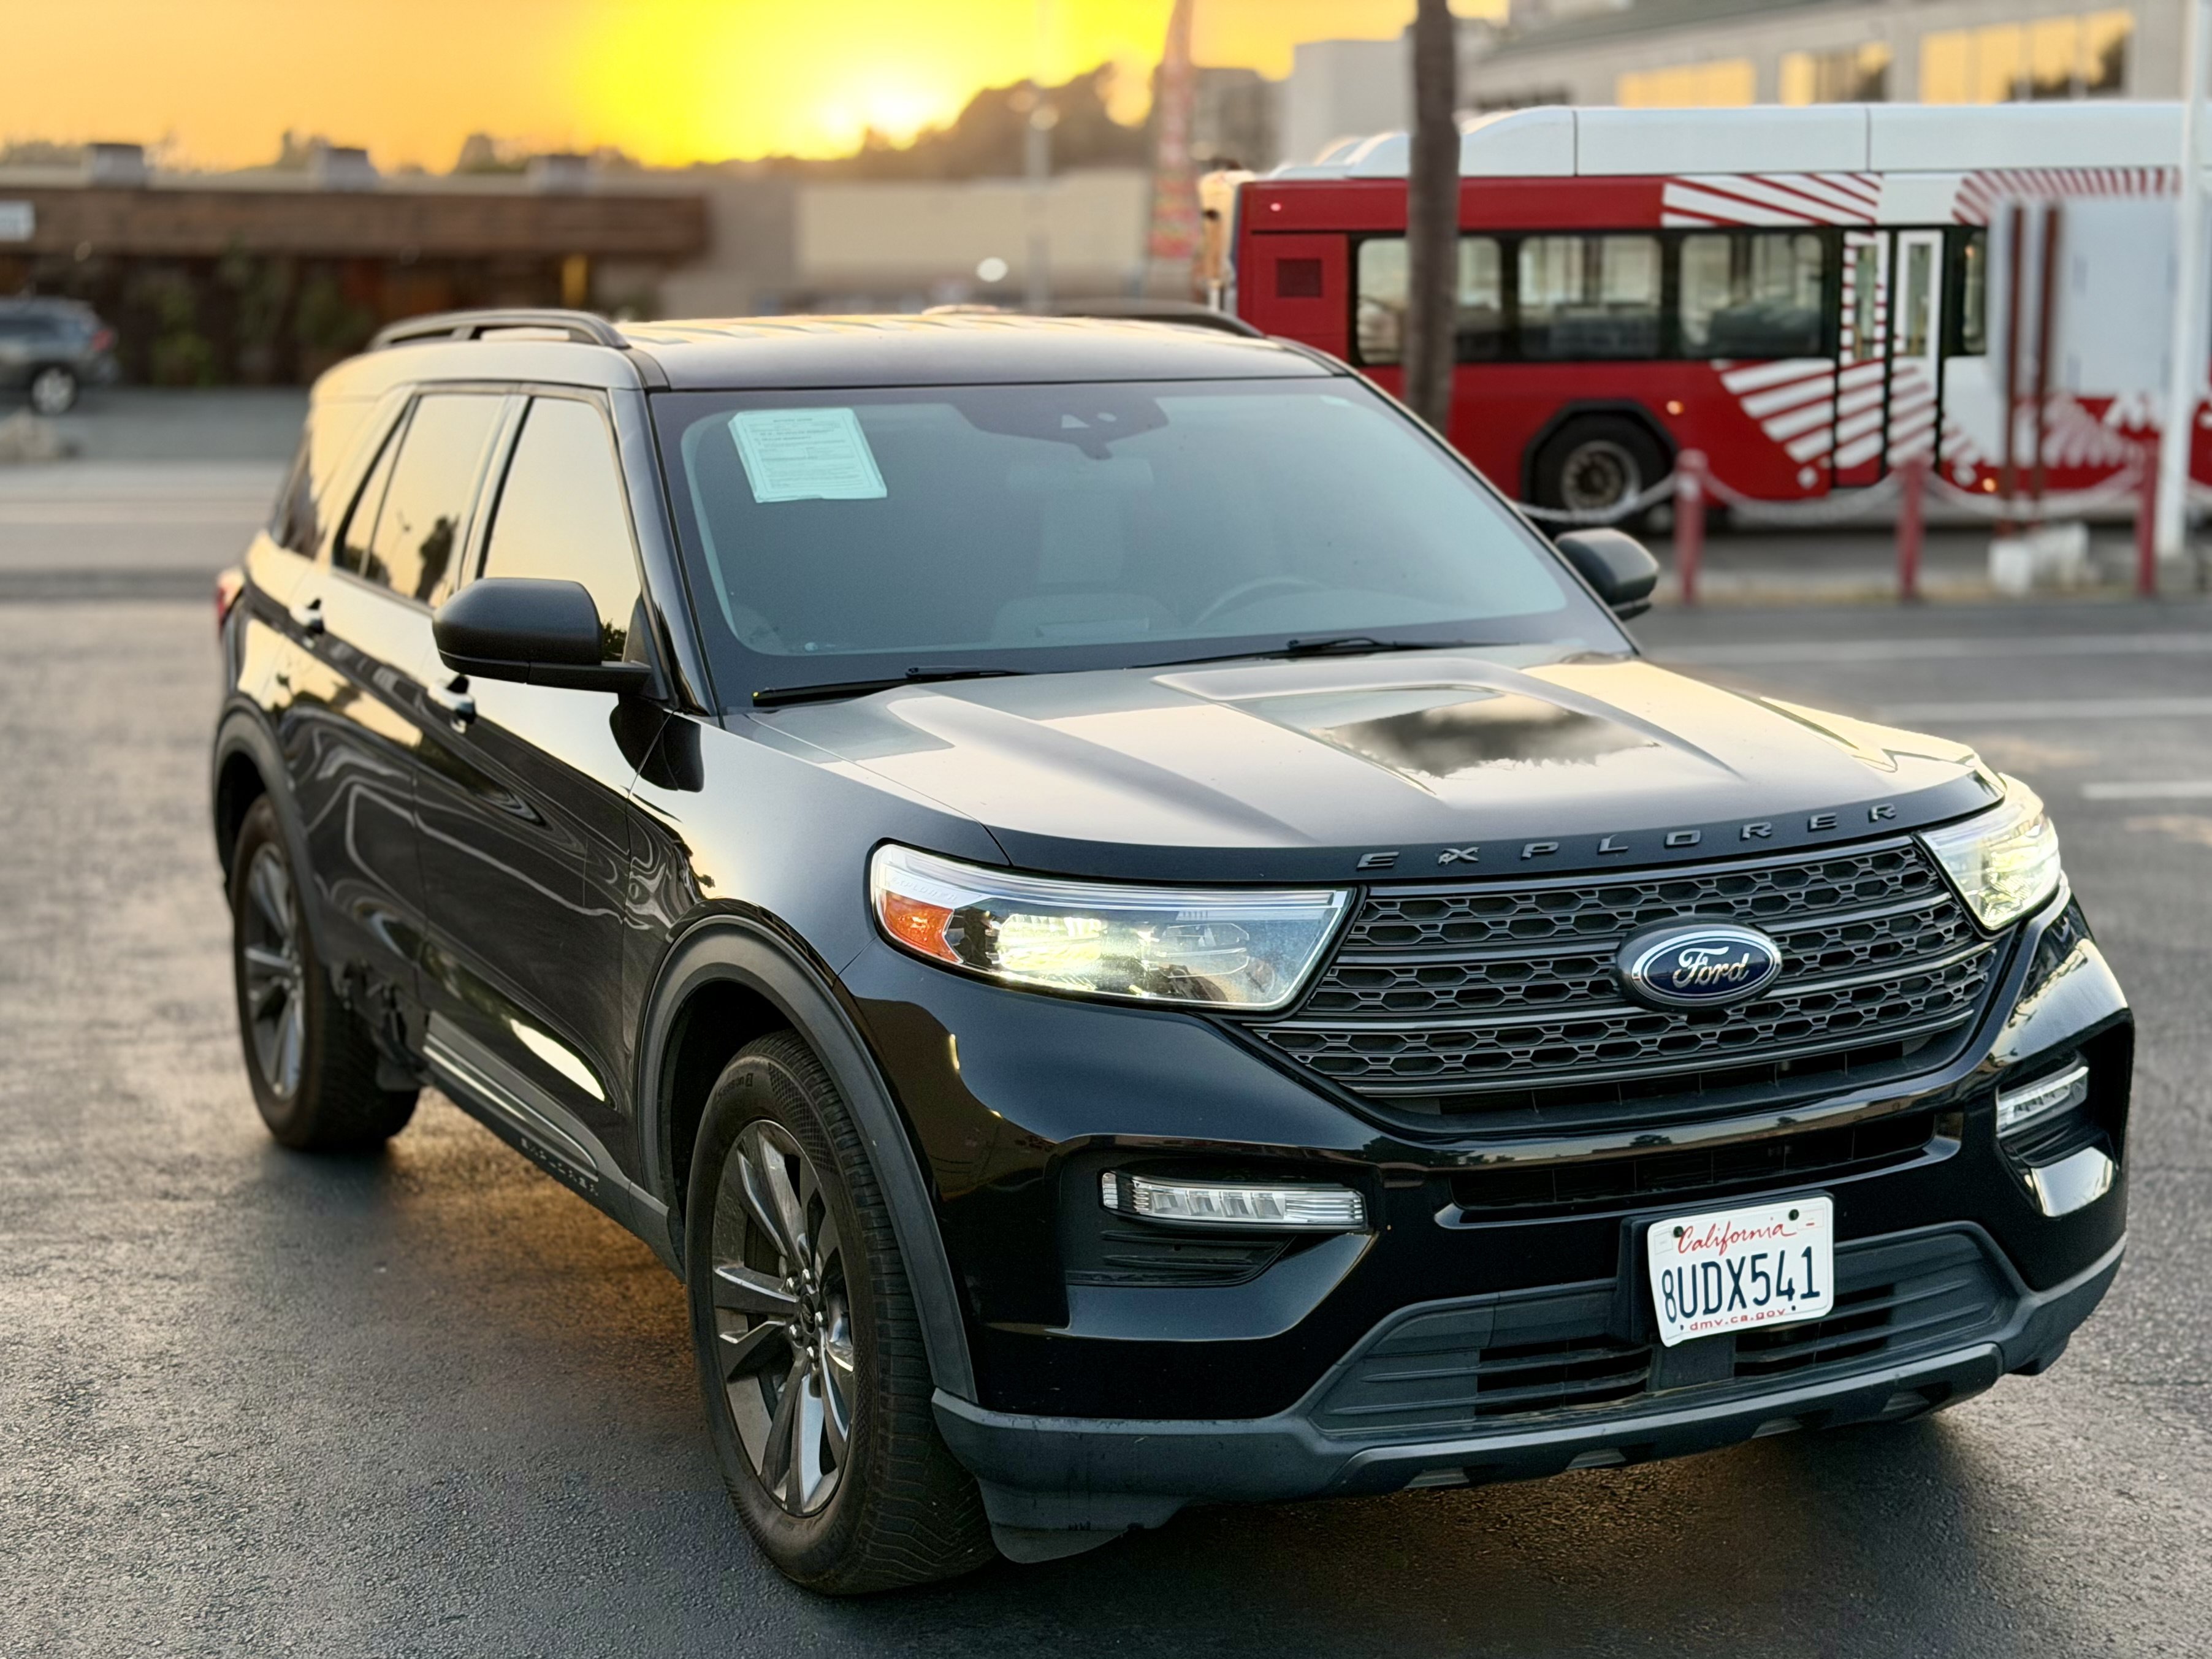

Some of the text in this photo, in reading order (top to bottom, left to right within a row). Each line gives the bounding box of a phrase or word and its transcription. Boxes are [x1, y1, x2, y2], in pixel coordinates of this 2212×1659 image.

[1356, 803, 1896, 870] EXPLORER
[1672, 946, 1750, 988] Ford
[1677, 1219, 1797, 1256] California
[1661, 1245, 1821, 1324] 8UDX541
[1690, 1308, 1785, 1331] dmv.ca.gov
